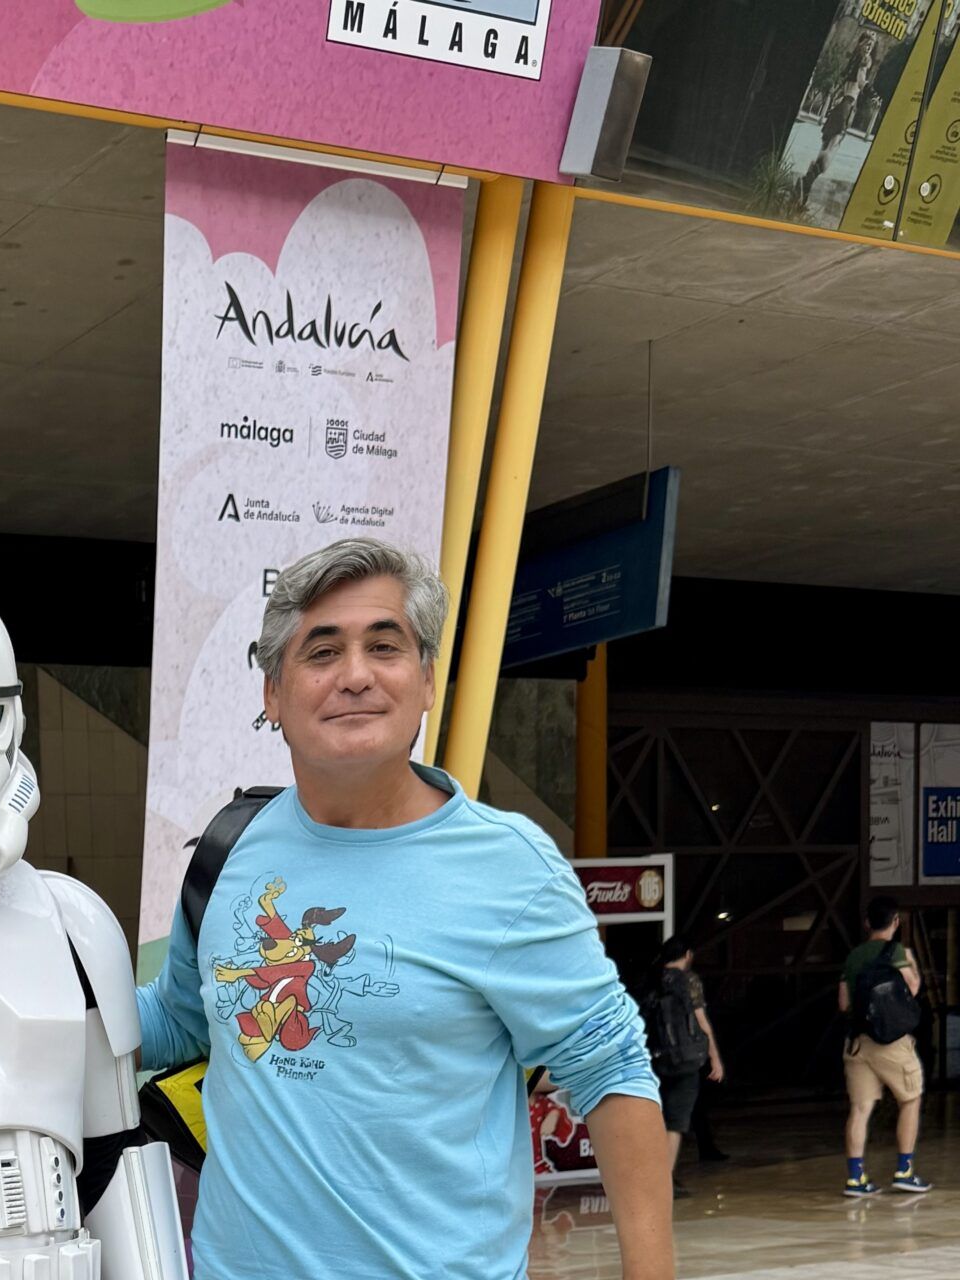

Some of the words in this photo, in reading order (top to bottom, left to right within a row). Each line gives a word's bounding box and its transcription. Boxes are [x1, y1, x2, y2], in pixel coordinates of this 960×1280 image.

[342, 0, 530, 66] MÁLAGA
[214, 280, 410, 362] Andalucía
[352, 430, 386, 443] Ciudad
[352, 444, 364, 455] de
[366, 444, 398, 458] Málaga
[244, 498, 270, 509] Junta
[243, 510, 255, 520] de
[256, 510, 300, 523] Andalucía
[340, 504, 369, 516] Agencia
[371, 507, 394, 518] Digital
[339, 516, 349, 525] de
[350, 516, 385, 528] Andalucía
[927, 820, 956, 843] Hall
[586, 881, 631, 904] Funko
[639, 877, 659, 901] 105
